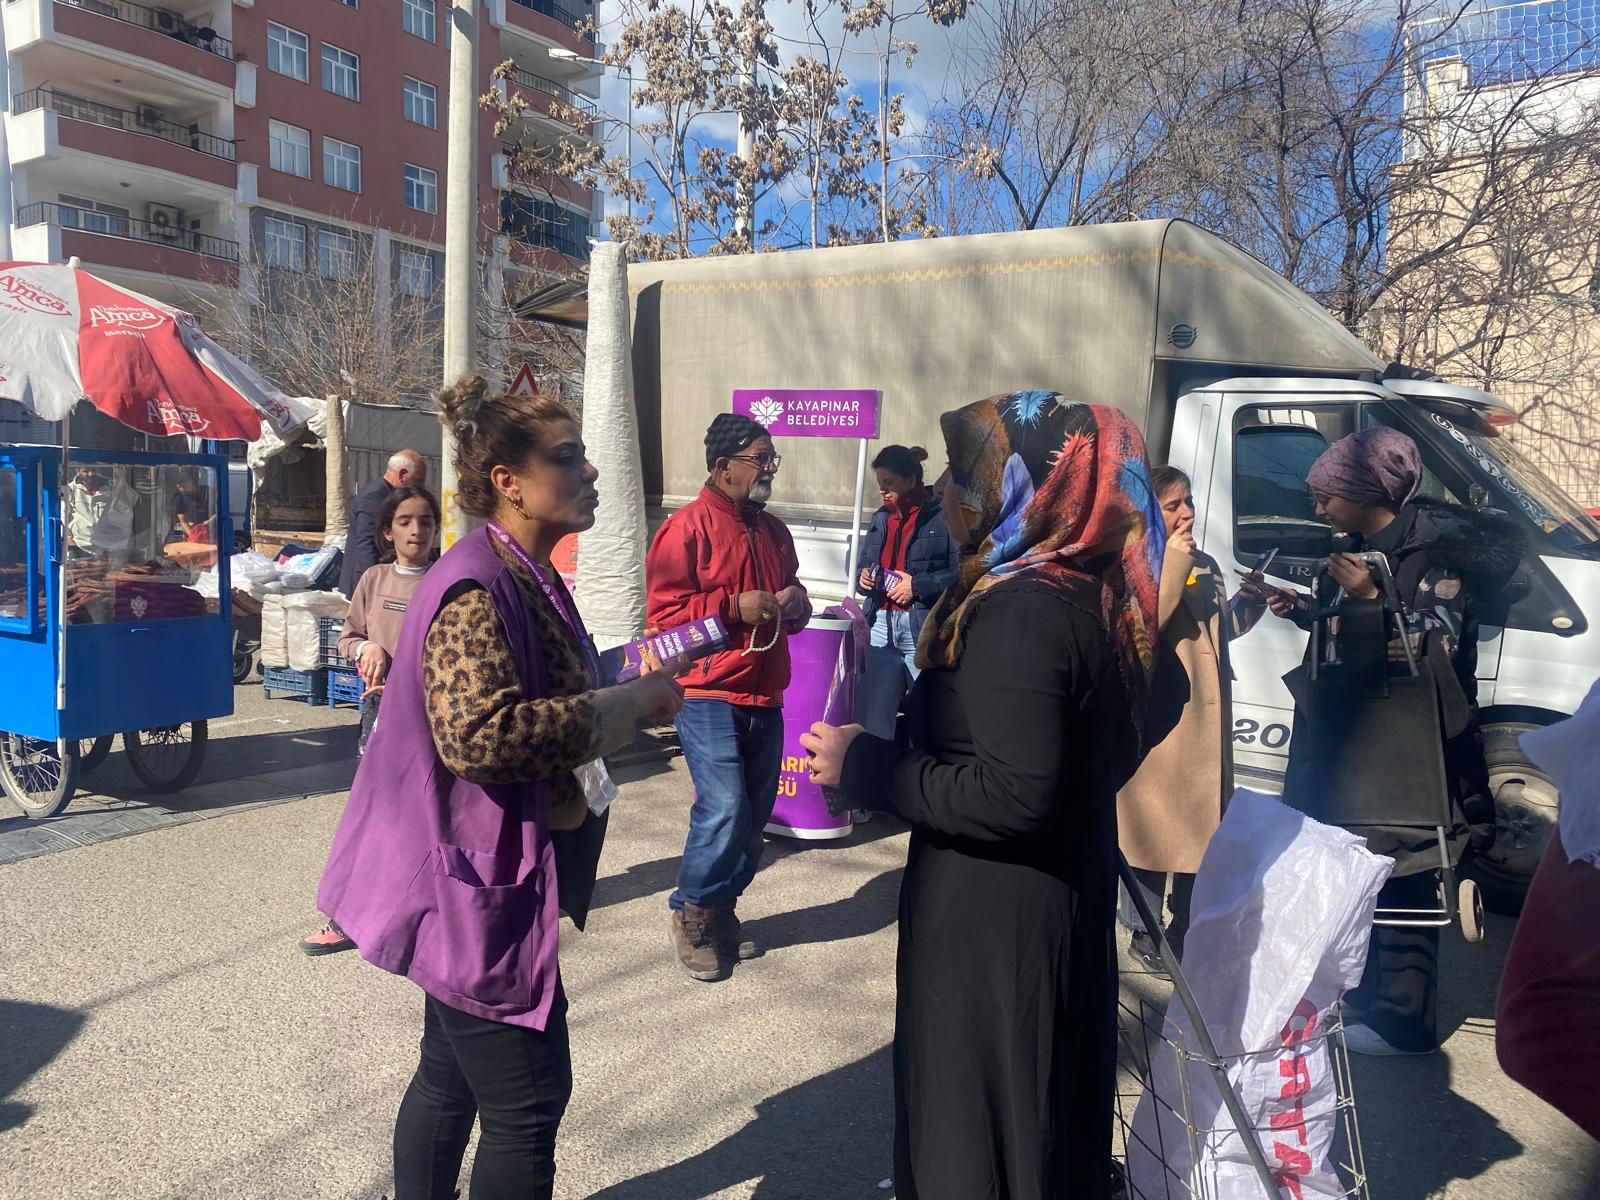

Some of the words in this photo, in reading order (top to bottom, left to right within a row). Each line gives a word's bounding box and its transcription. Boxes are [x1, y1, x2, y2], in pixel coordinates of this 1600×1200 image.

[0, 275, 66, 311] Amca
[89, 307, 157, 328] Amca
[147, 400, 202, 424] Amca
[787, 401, 860, 412] KAYAPINAR
[787, 413, 859, 426] BELEDİYESİ
[1289, 565, 1312, 577] TR
[1232, 718, 1291, 749] 20
